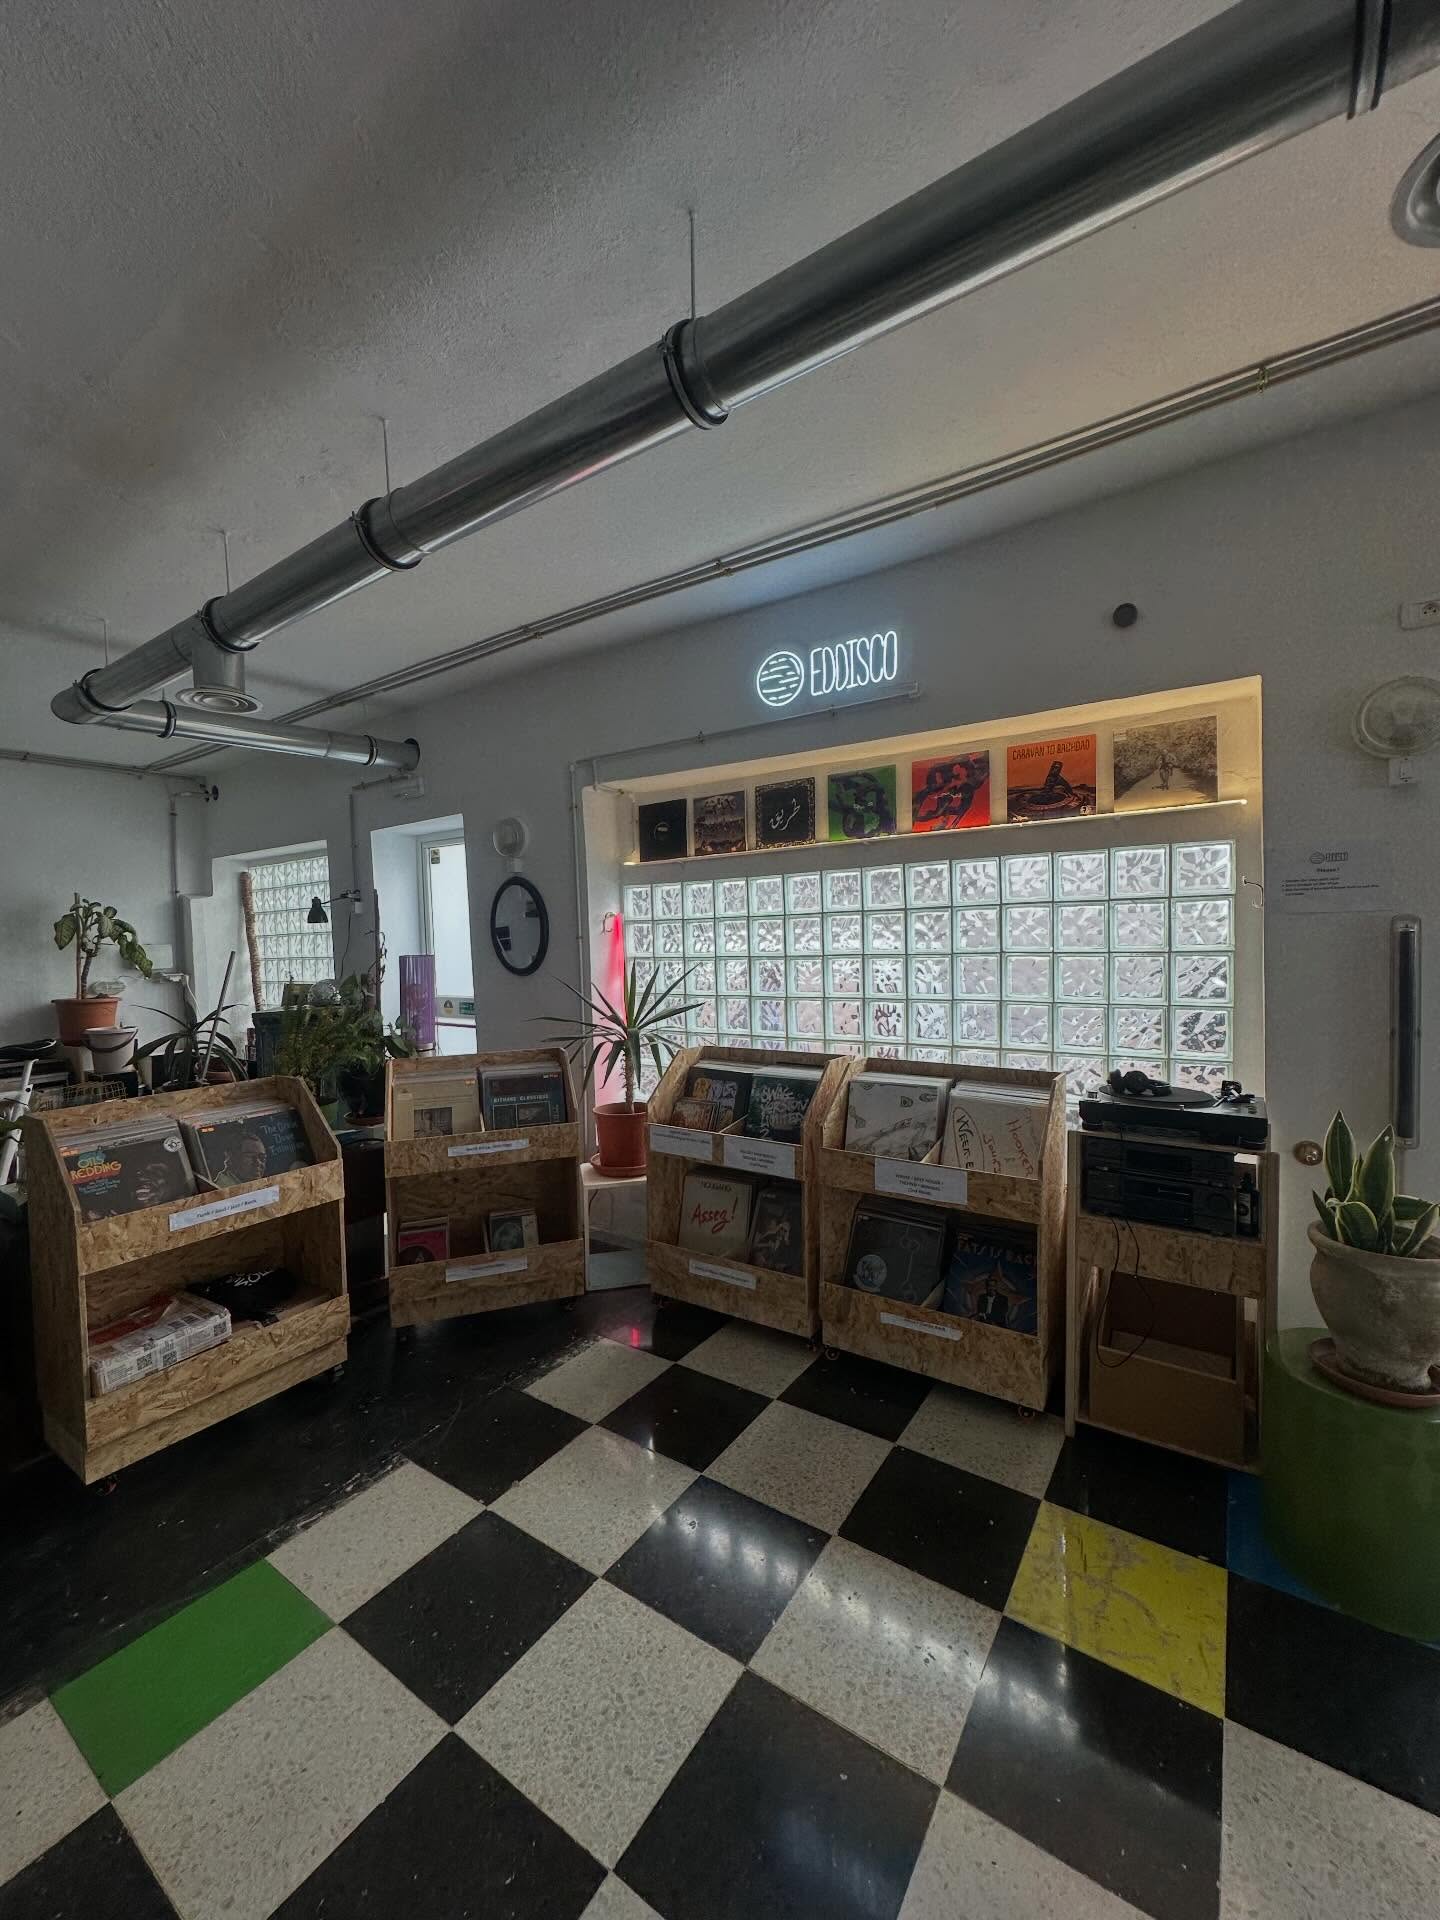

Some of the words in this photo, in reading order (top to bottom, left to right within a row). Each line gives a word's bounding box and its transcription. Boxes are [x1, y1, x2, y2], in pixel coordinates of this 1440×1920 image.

[811, 631, 898, 696] EDDISCO
[1012, 747, 1045, 760] CARAVAN
[1047, 744, 1056, 755] TO
[1057, 739, 1090, 754] BAGHDAD
[956, 1115, 974, 1158] WEEK
[70, 1161, 122, 1180] REDDING
